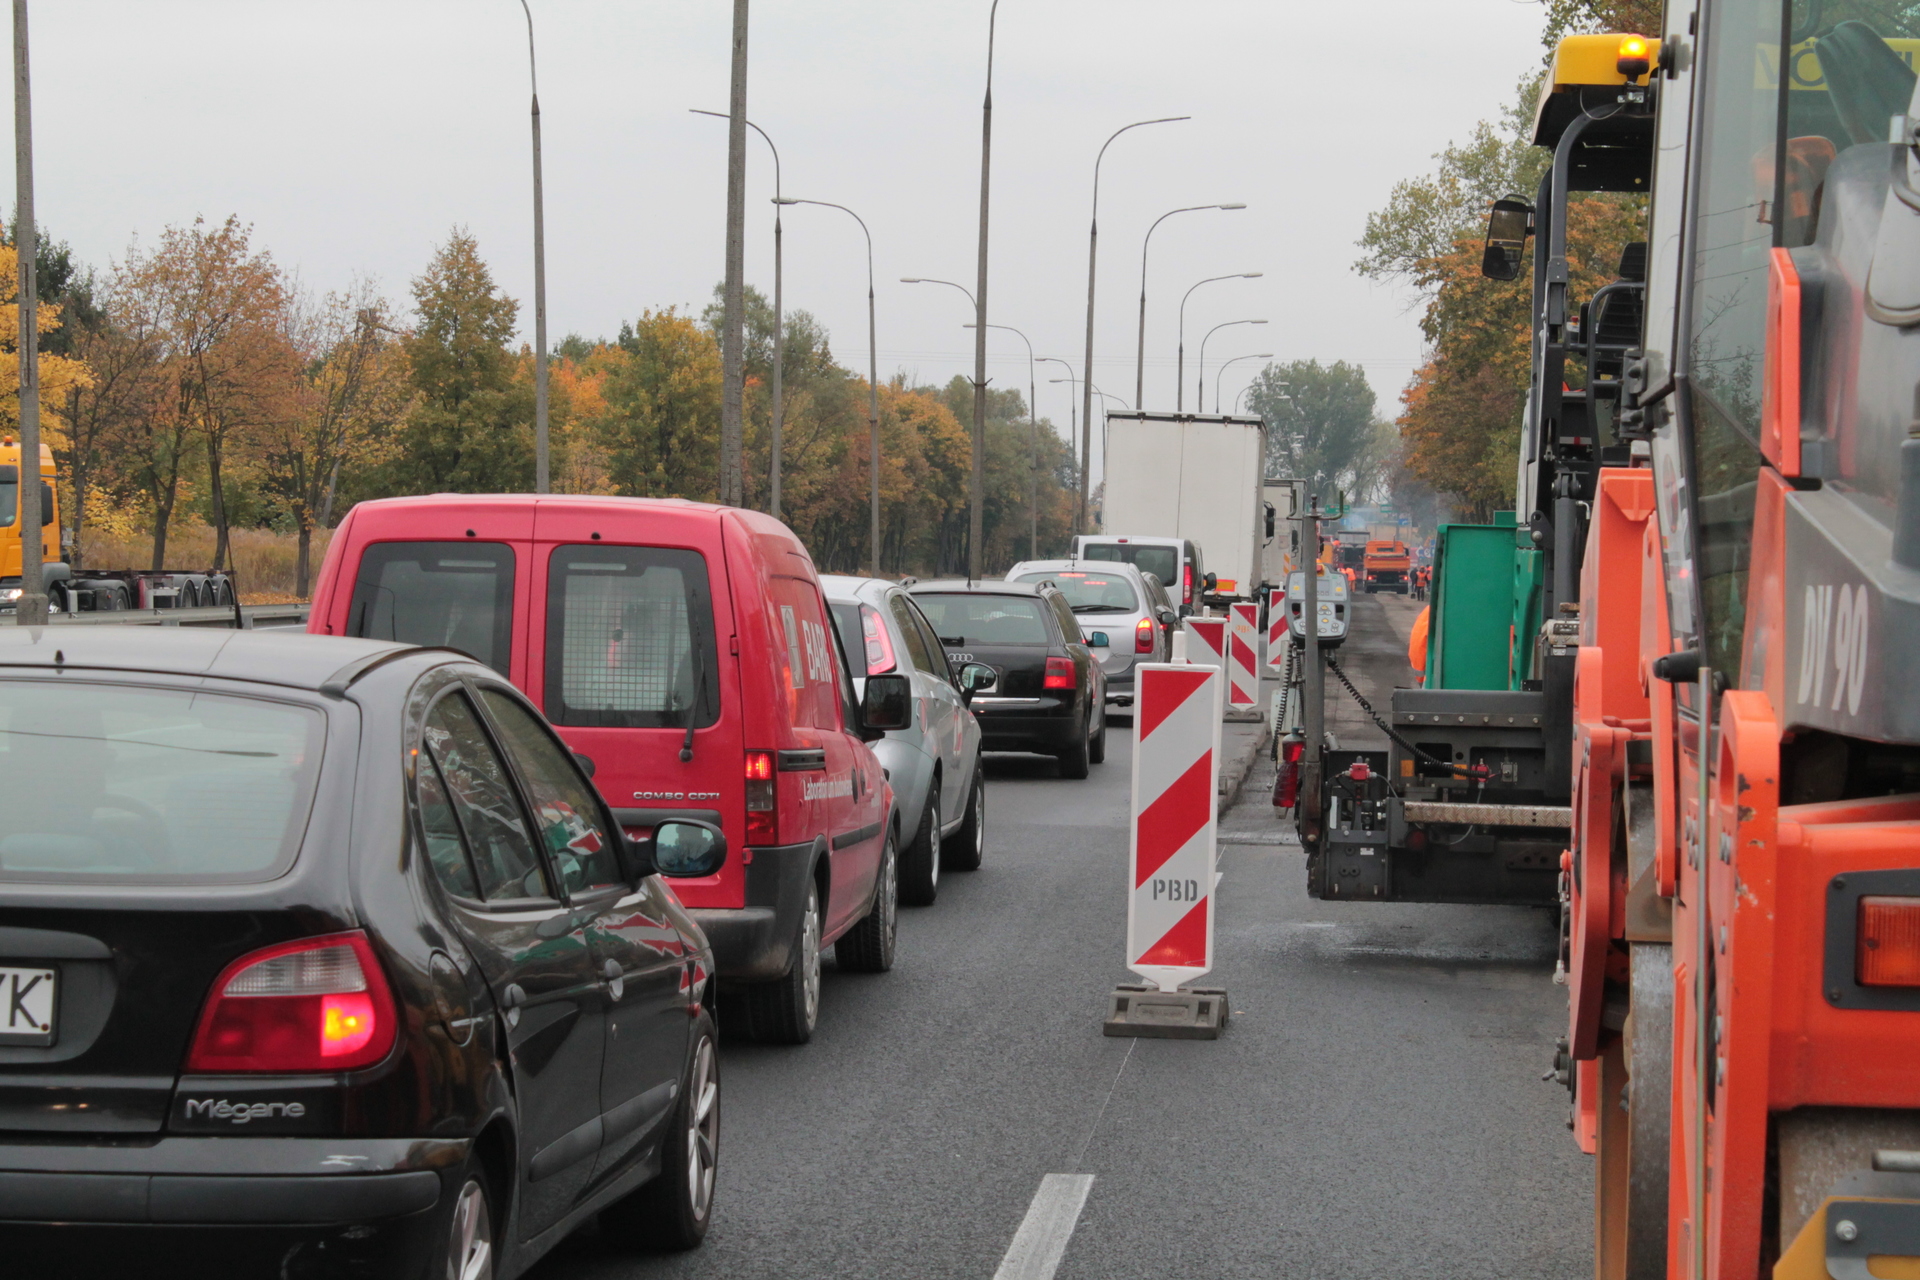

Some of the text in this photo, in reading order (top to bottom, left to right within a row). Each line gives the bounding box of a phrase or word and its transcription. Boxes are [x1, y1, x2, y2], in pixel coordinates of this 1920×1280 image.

[1797, 582, 1869, 717] DV 90
[632, 791, 720, 800] COMBO CDTI
[1152, 879, 1198, 902] PBD
[0, 972, 43, 1029] K
[186, 1098, 306, 1124] Mégane
